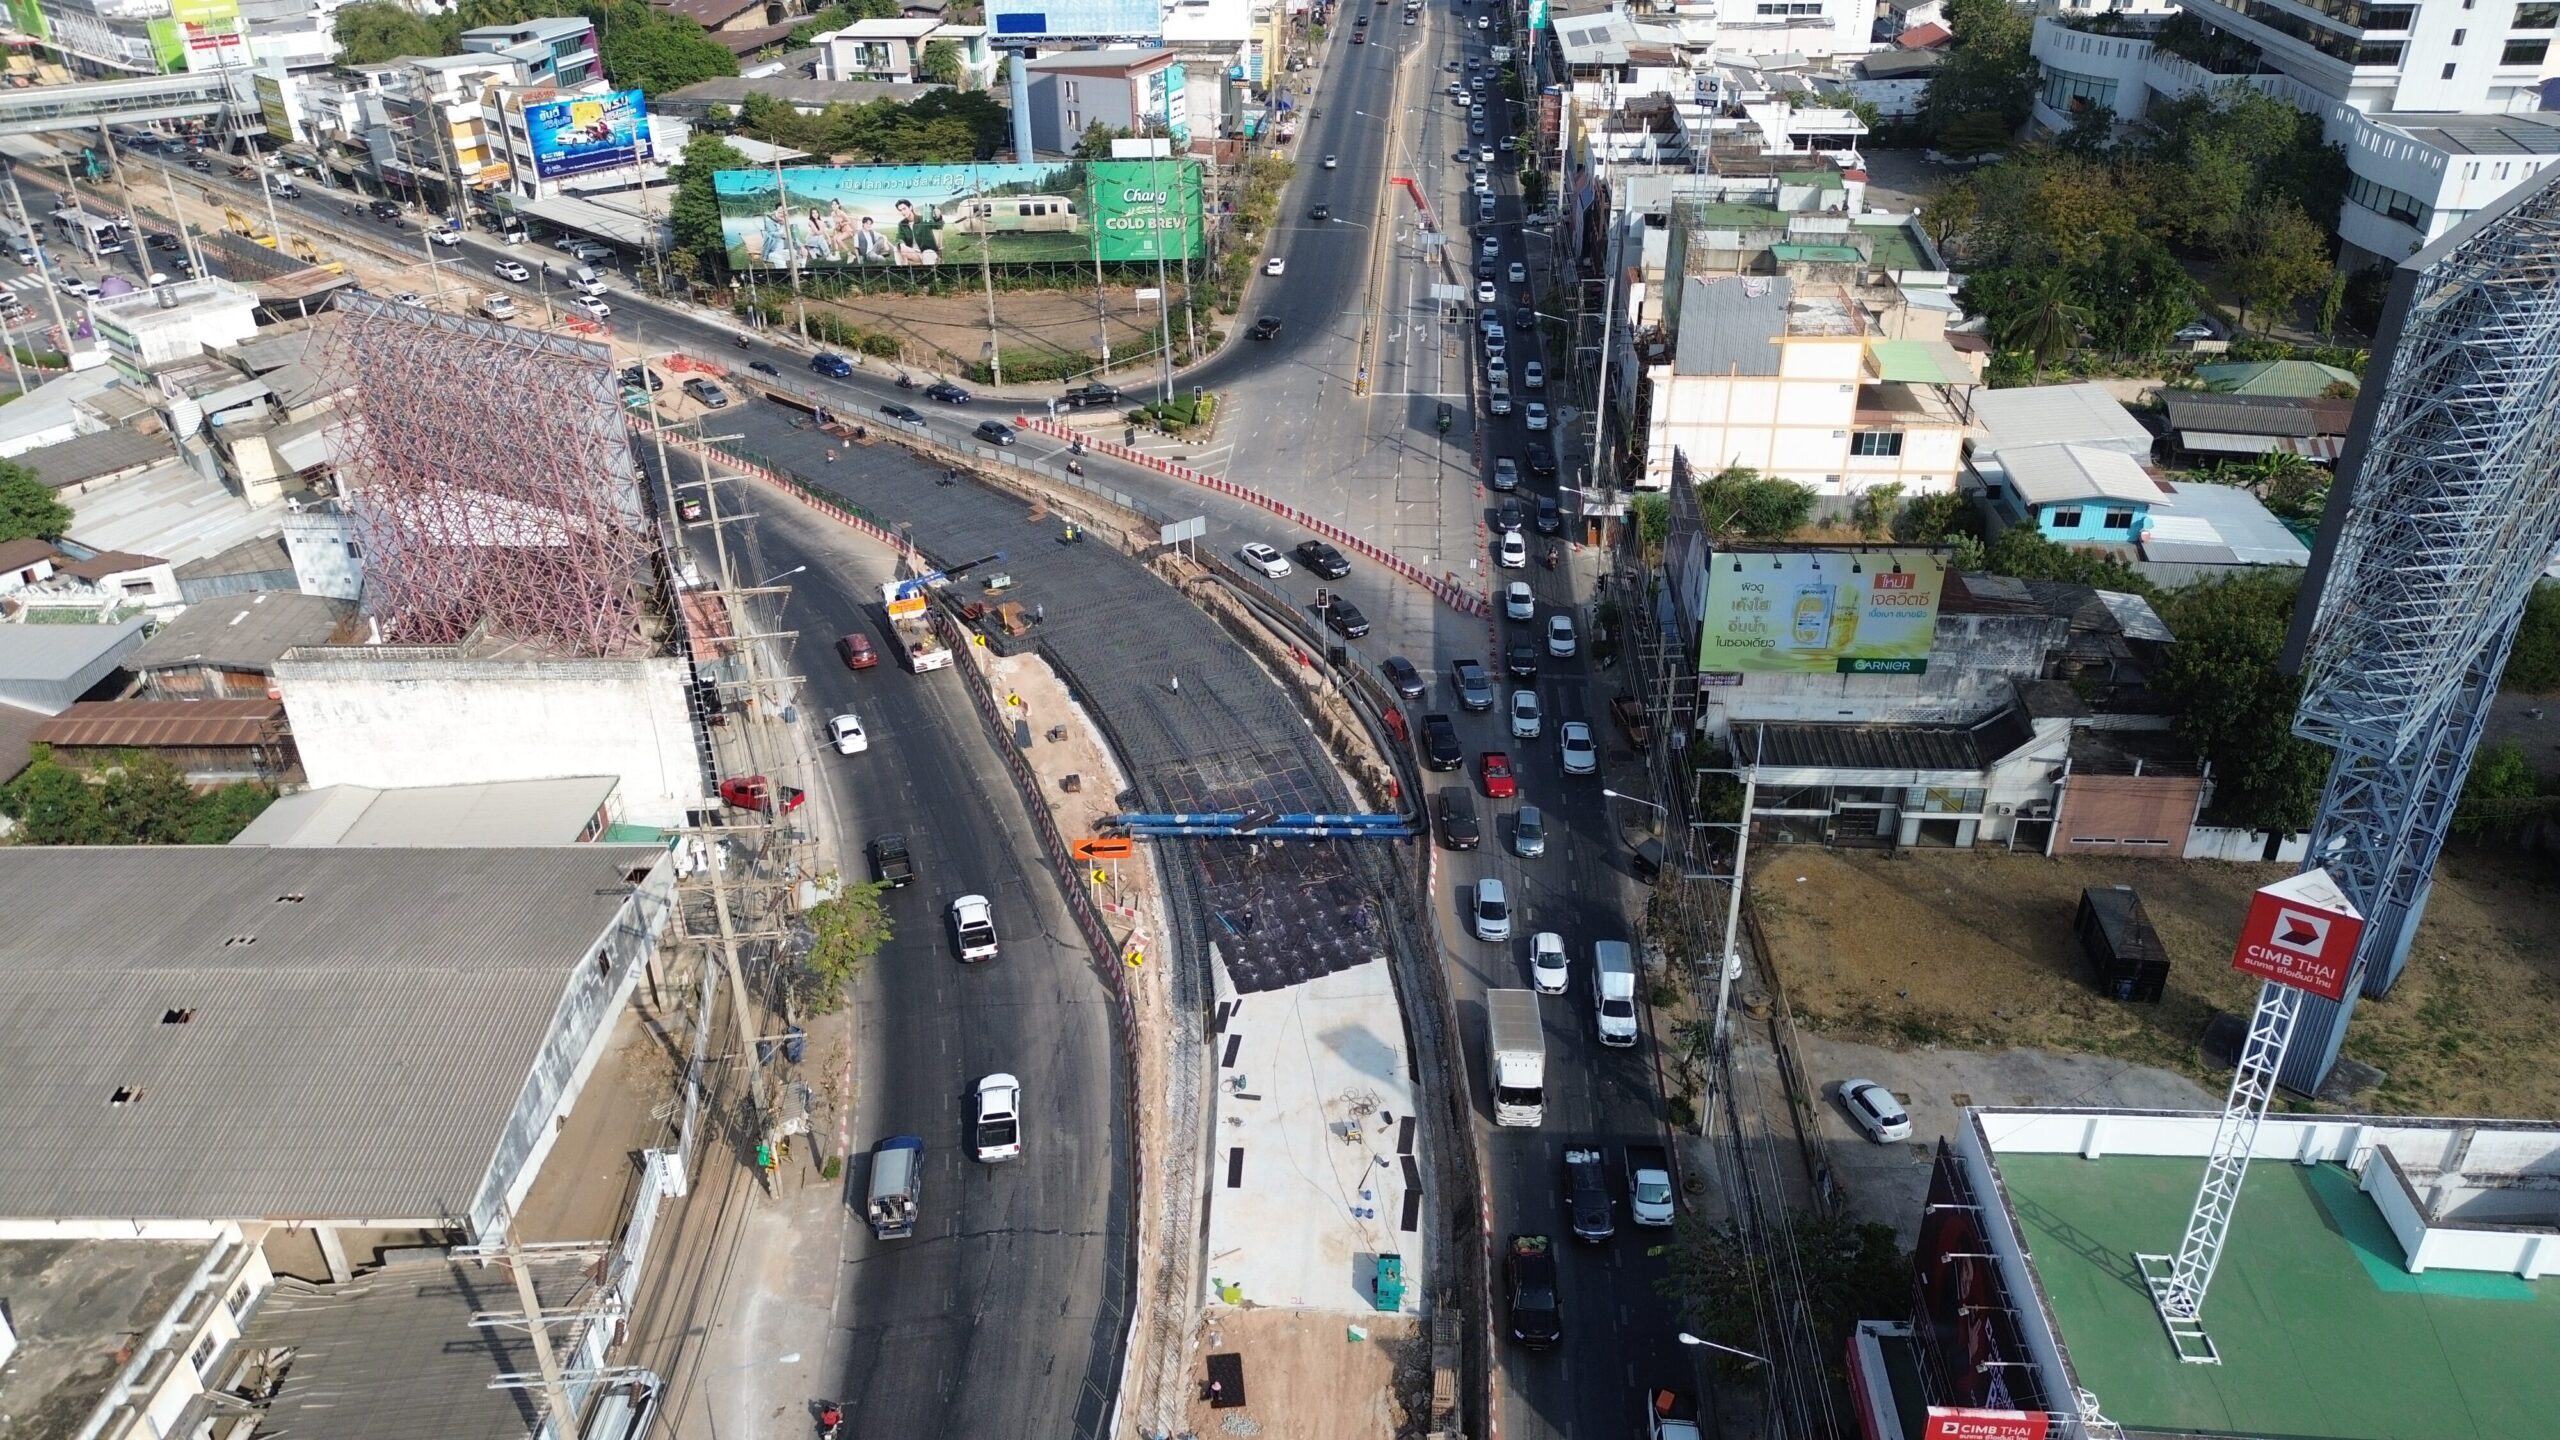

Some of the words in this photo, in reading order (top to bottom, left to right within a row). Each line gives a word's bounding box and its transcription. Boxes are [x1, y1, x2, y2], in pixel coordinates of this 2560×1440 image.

[1698, 80, 1718, 92] ttb
[1105, 218, 1146, 230] COLD
[1881, 574, 1908, 589] ใหม่!
[1741, 582, 1765, 594] ผิวดู
[1715, 635, 1776, 648] ในซองเดียว
[1854, 659, 1911, 671] GARNIER
[2247, 945, 2293, 966] CIMB
[2297, 958, 2336, 979] THAI
[2244, 957, 2274, 972] ธนาคาร
[2315, 976, 2331, 989] ไทย
[1961, 1424, 1997, 1435] CIMB
[2000, 1426, 2031, 1436] THAI
